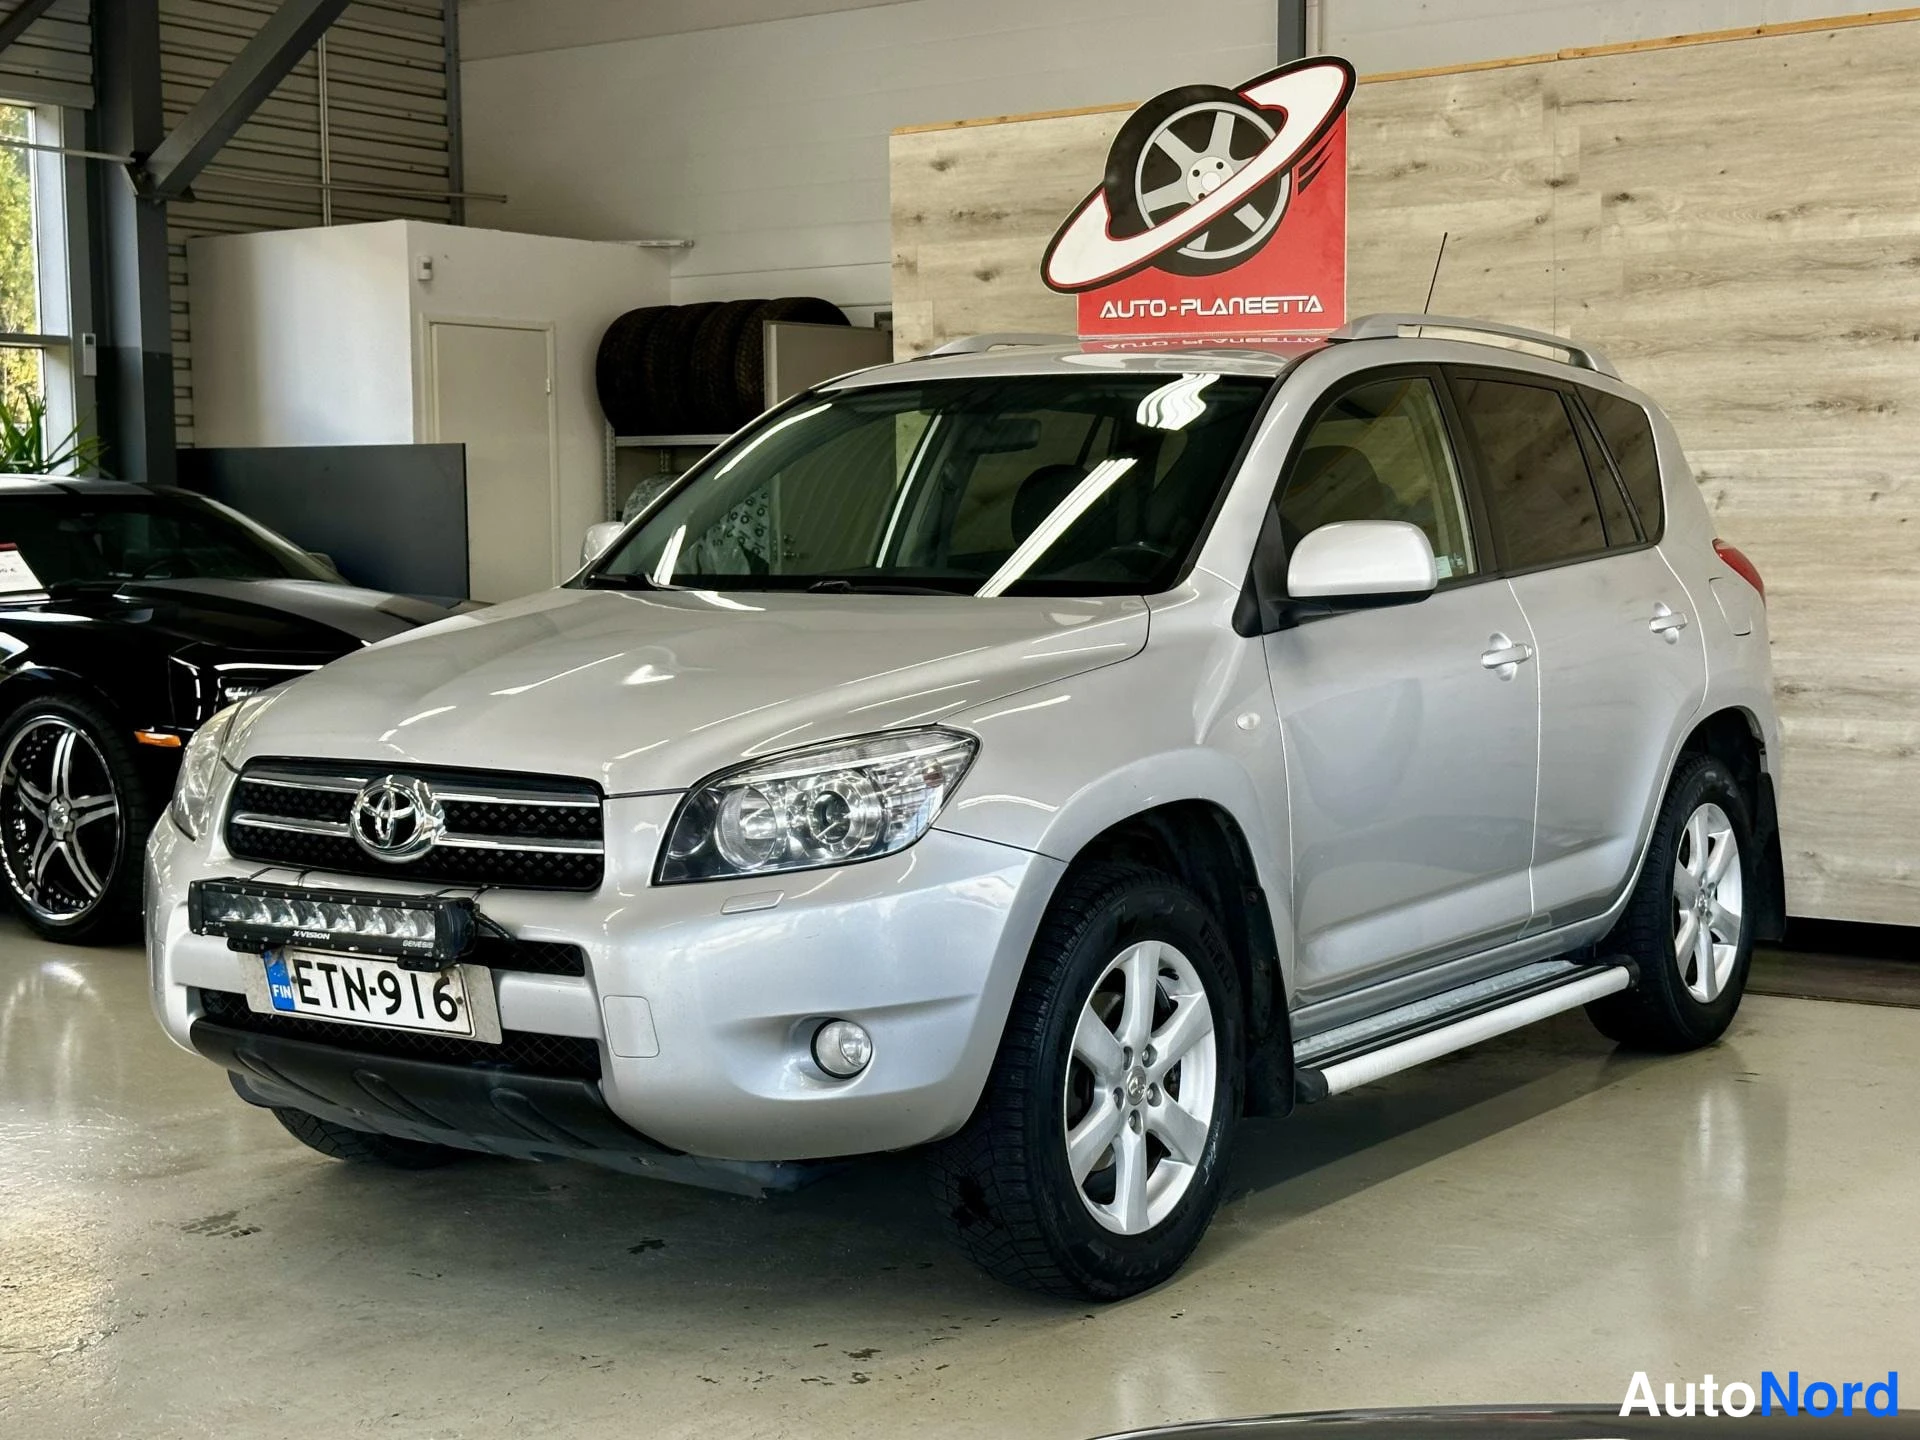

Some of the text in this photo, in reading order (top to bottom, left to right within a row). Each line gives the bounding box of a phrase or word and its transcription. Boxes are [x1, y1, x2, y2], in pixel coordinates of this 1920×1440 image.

[1100, 295, 1324, 319] AUTO-PLANEETTA
[402, 939, 435, 949] GENESIS
[273, 983, 292, 1000] FIN
[293, 958, 459, 1023] ETN-916
